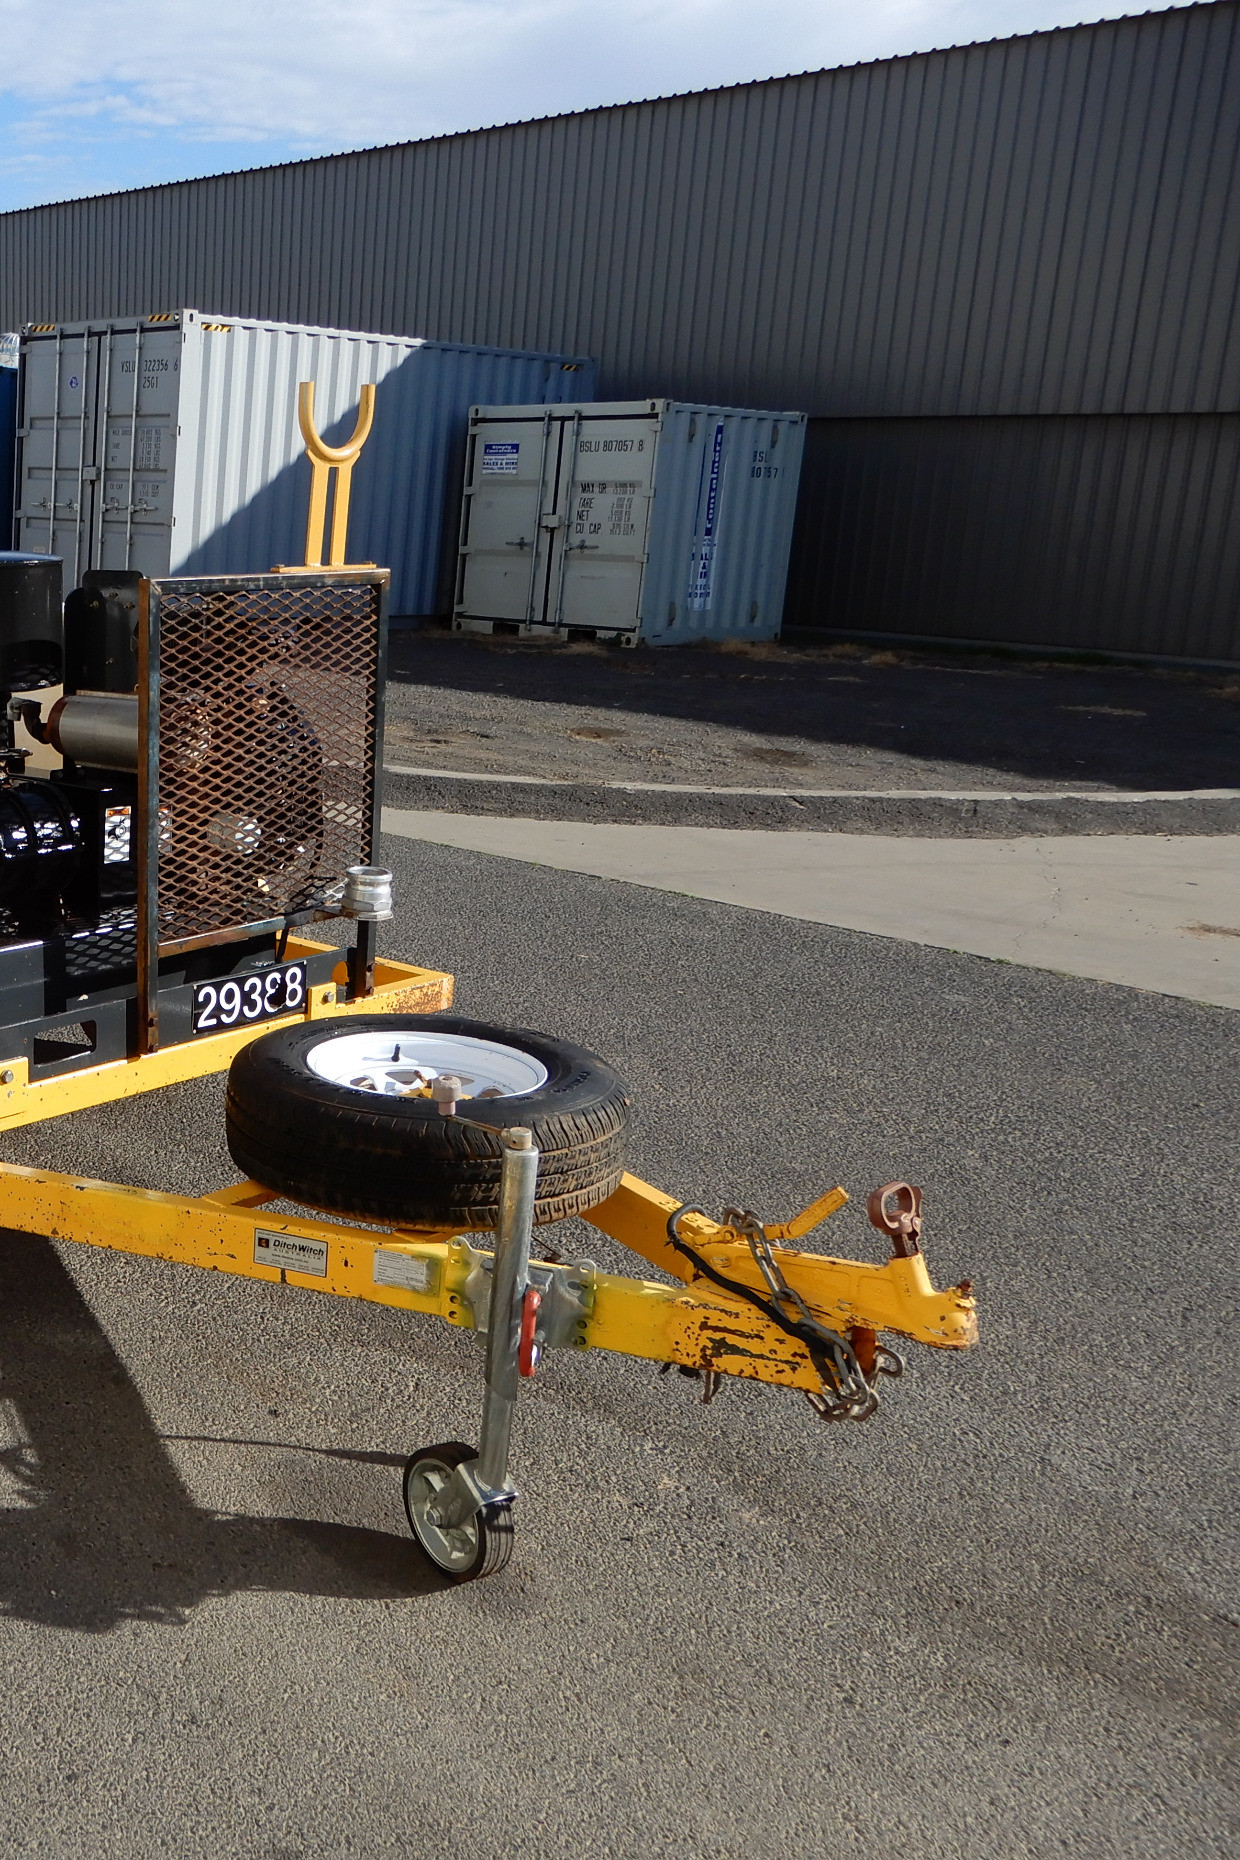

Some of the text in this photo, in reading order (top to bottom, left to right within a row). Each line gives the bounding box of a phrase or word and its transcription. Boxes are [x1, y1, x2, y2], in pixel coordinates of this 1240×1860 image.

[121, 358, 179, 372] VSLU 322356 6
[580, 440, 644, 453] BSLU 807057 8
[577, 510, 589, 521] NET
[198, 967, 303, 1029] 29388
